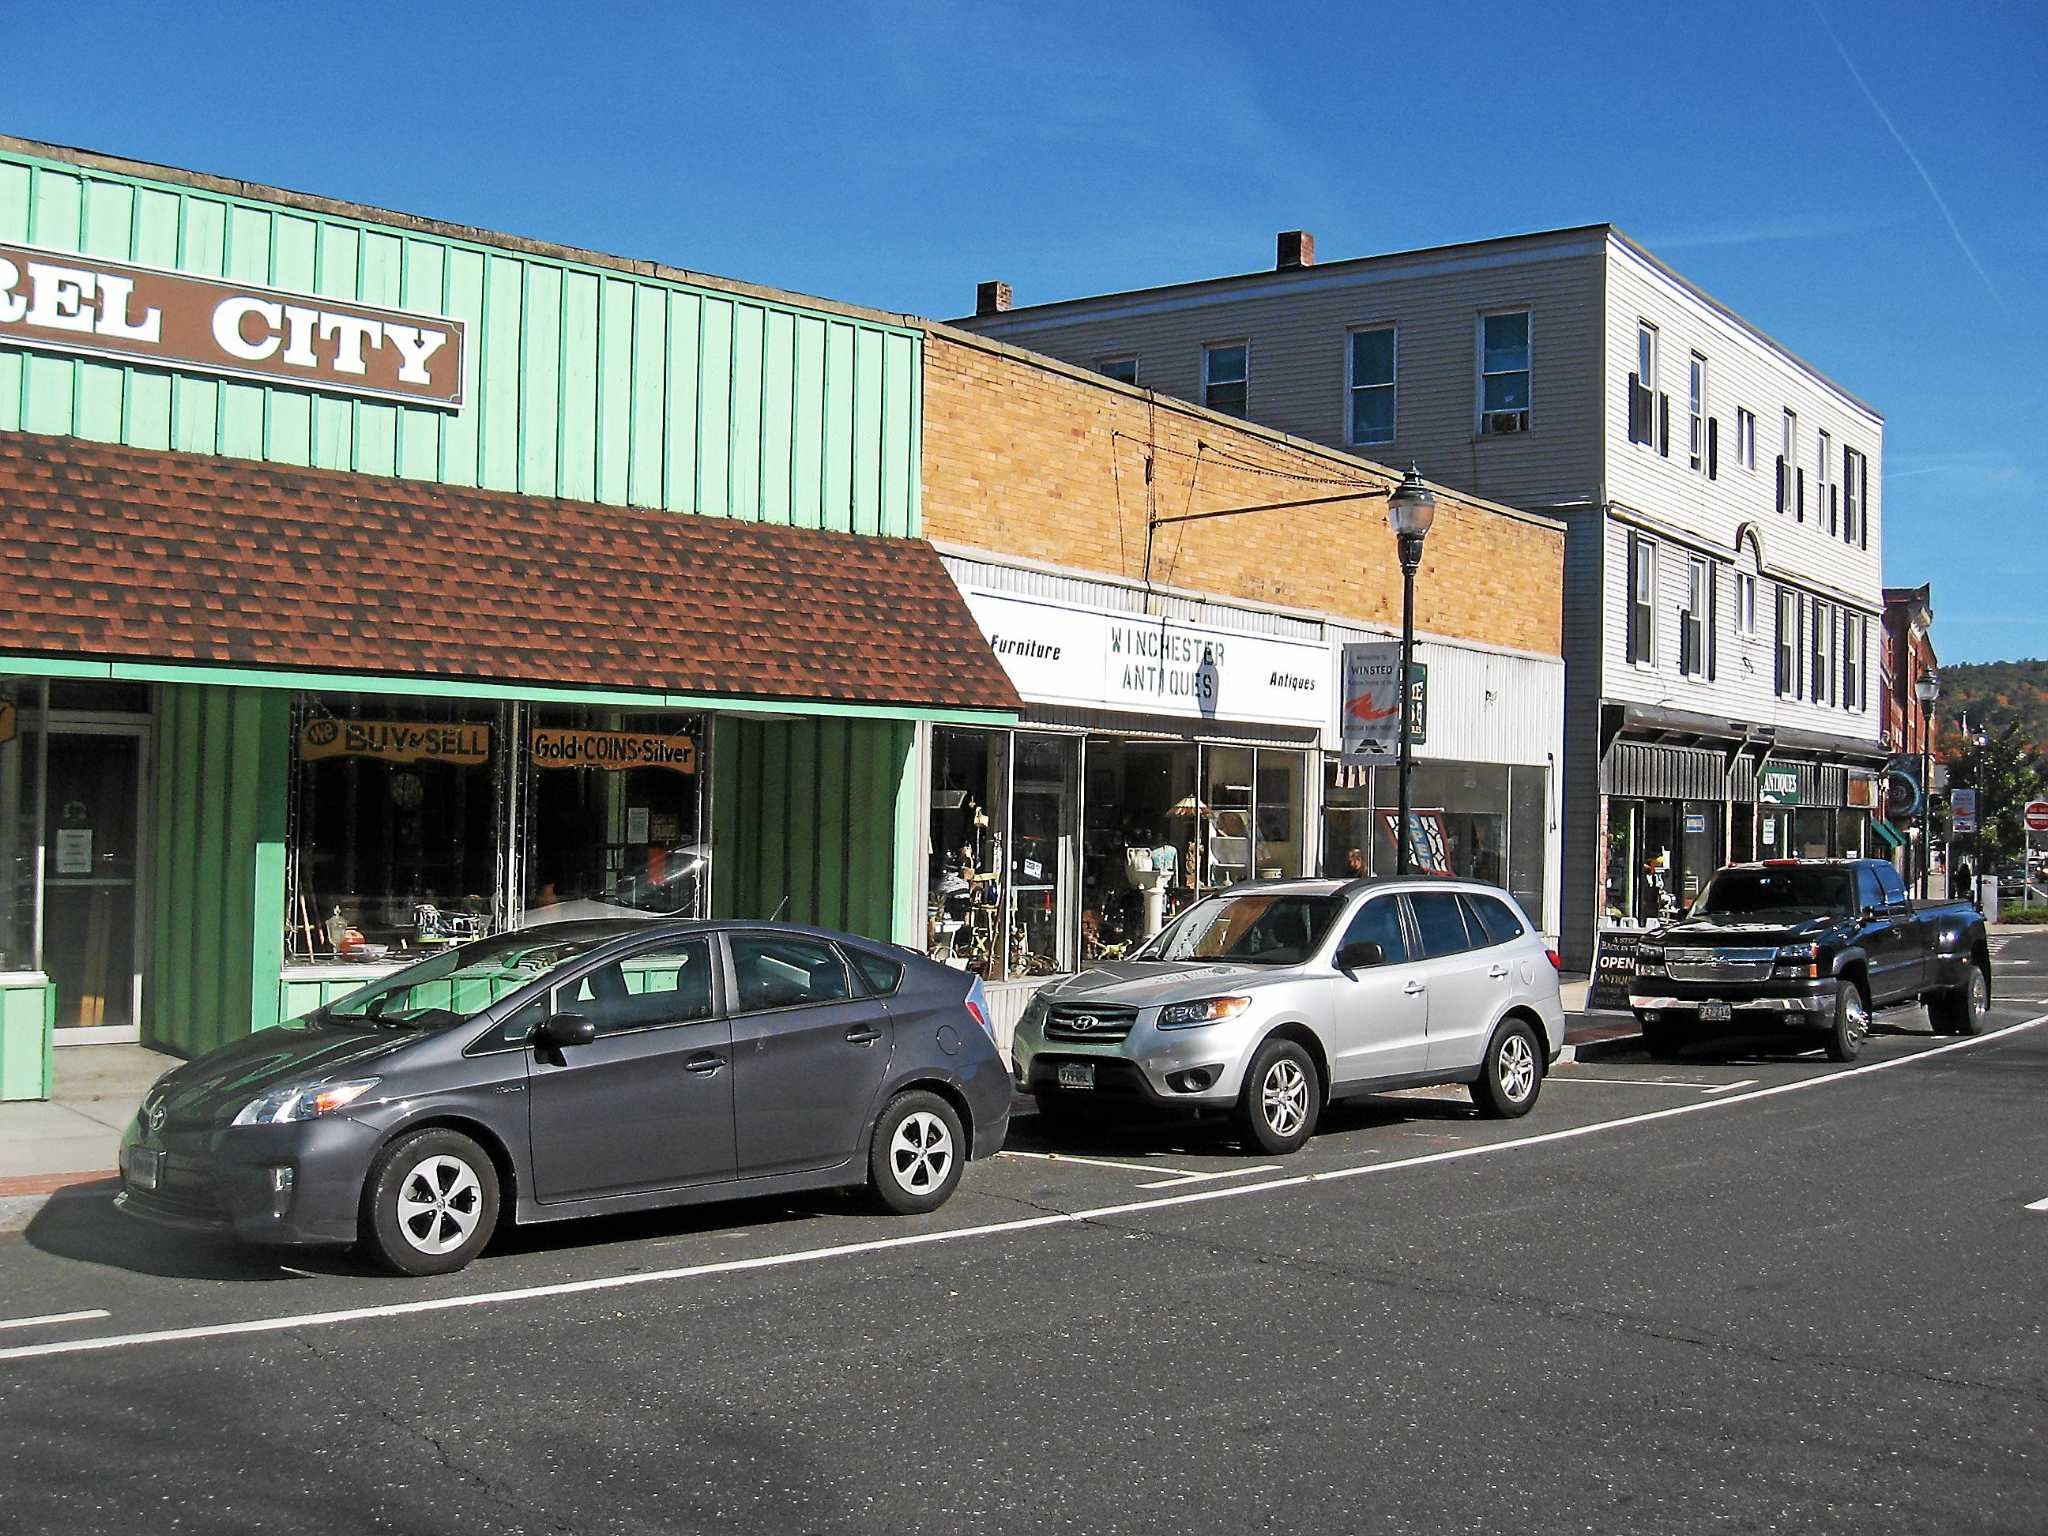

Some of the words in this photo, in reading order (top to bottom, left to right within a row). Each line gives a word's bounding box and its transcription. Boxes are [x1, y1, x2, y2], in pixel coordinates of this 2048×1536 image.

[211, 296, 446, 385] CITY
[991, 634, 1061, 661] Furniture
[1111, 626, 1225, 667] WINCHESTER
[1122, 663, 1213, 699] ANTIQUES
[1269, 671, 1316, 692] Antiques
[425, 728, 488, 755] SELL
[535, 733, 577, 759] Gold
[584, 736, 639, 761] COINS
[642, 738, 692, 763] Silver
[1764, 772, 1797, 796] ANTIQUES
[1600, 956, 1635, 969] OPEN
